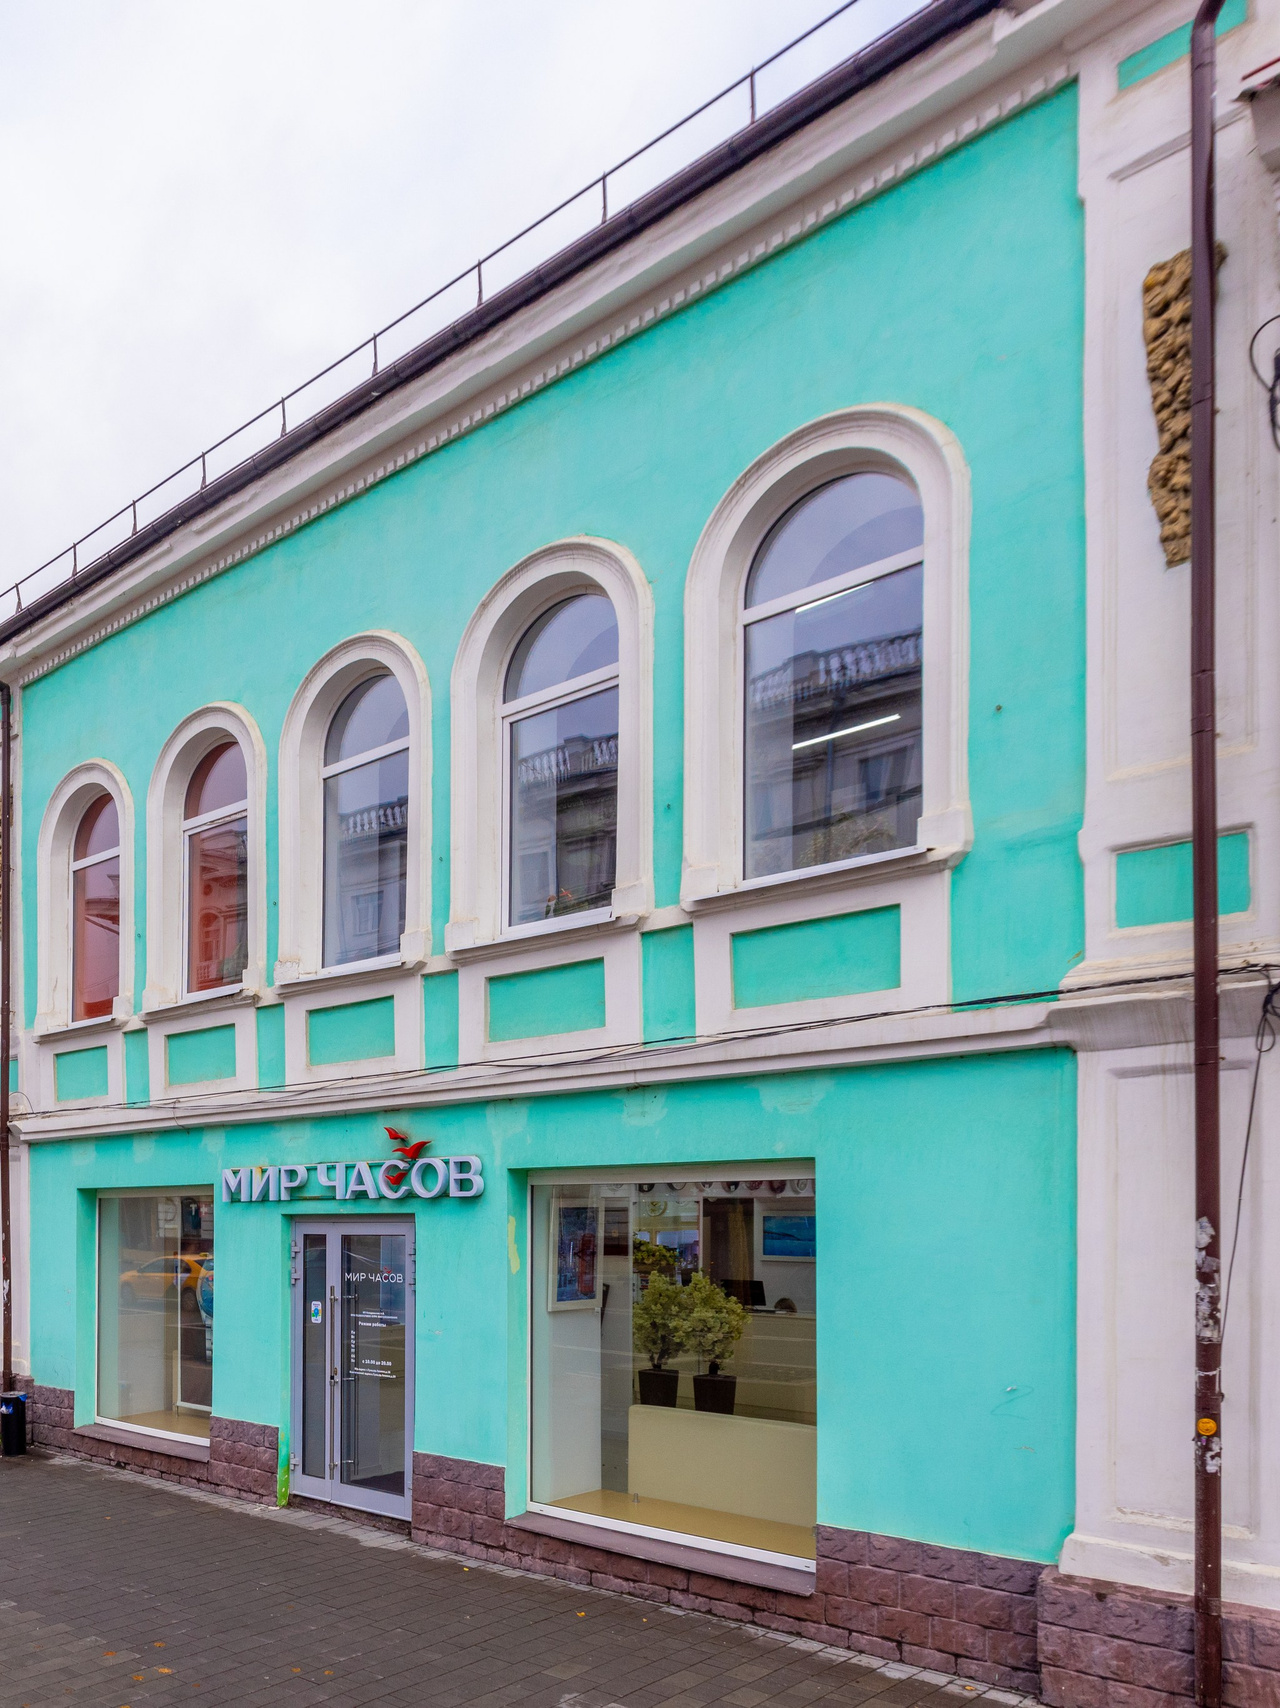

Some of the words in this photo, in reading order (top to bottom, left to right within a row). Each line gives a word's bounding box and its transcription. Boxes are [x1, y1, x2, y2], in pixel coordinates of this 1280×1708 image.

[222, 1165, 308, 1202] МИР
[316, 1156, 485, 1200] ЧАСОВ
[345, 1273, 367, 1282] МИР
[369, 1273, 404, 1283] ЧАСОВ
